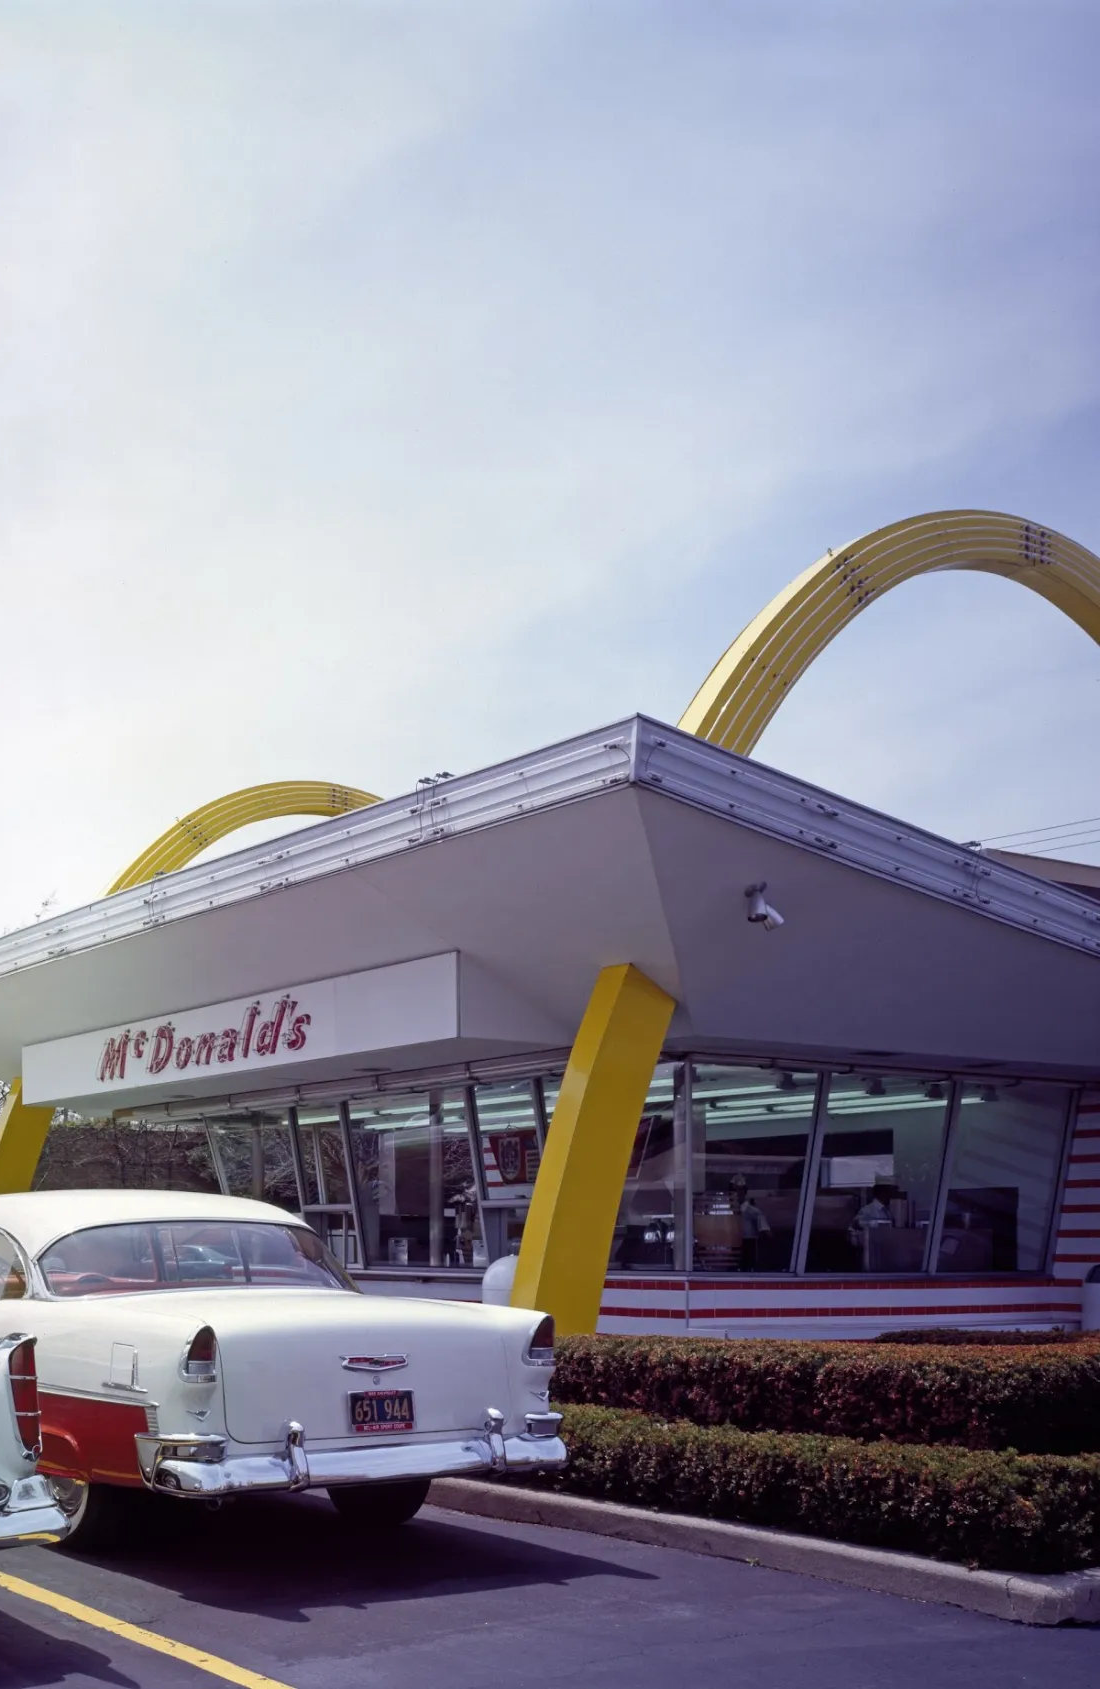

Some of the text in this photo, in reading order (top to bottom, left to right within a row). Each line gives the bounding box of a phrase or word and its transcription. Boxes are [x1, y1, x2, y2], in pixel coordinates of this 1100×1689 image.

[98, 997, 312, 1083] McDonald's
[355, 1398, 410, 1423] 651 944
